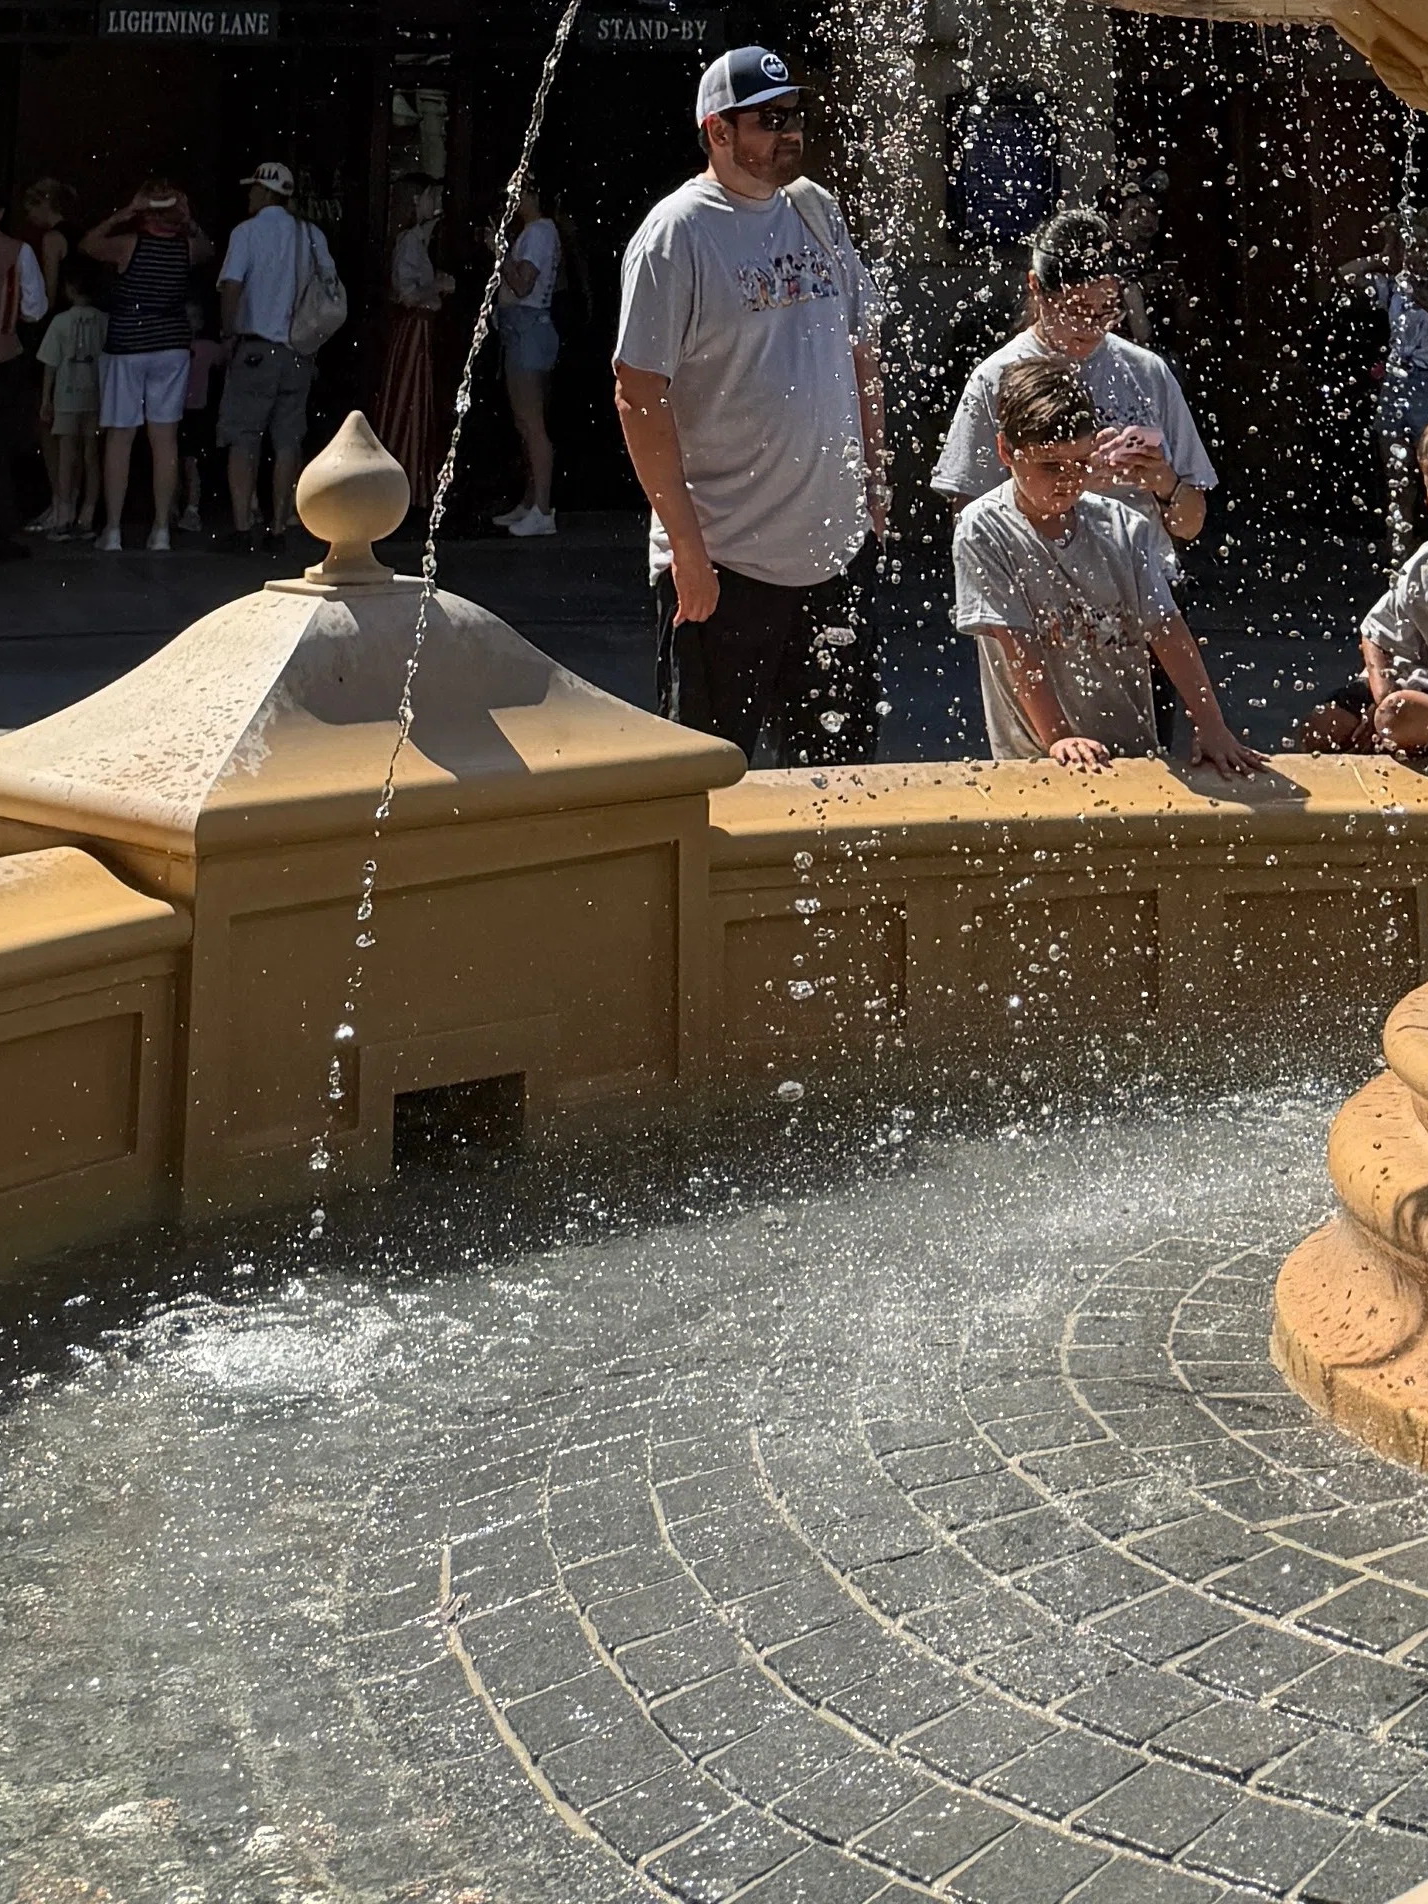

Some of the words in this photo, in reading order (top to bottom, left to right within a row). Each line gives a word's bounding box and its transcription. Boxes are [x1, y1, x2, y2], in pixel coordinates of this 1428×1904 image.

[107, 9, 215, 36] LIGHTNING
[220, 11, 270, 36] LANE
[597, 17, 709, 42] STAND-BY
